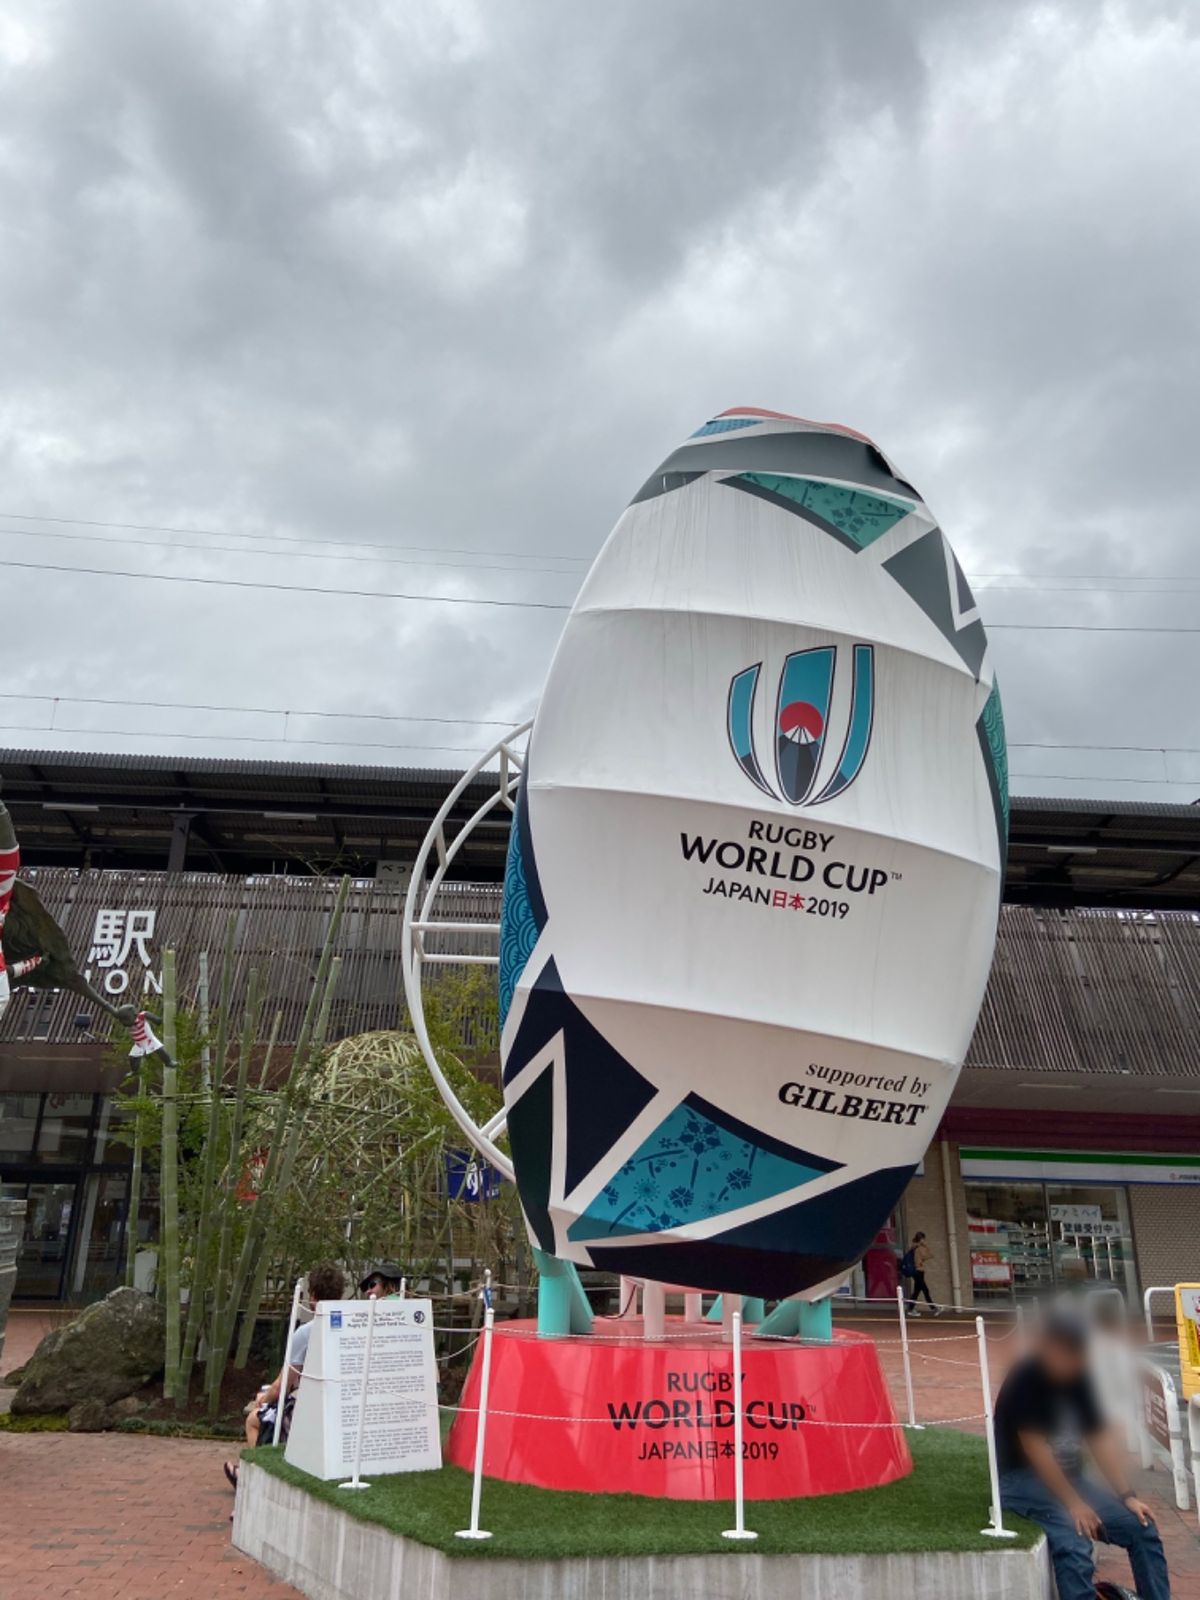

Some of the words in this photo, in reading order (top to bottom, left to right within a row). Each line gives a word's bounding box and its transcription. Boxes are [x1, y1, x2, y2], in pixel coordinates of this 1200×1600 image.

[748, 820, 835, 852] RUGBY
[680, 832, 815, 882] WORLD
[87, 909, 156, 967] 駅
[805, 1063, 908, 1093] supported
[909, 1076, 932, 1098] by
[778, 1081, 926, 1126] GILBERT
[607, 1399, 736, 1431] WORLD
